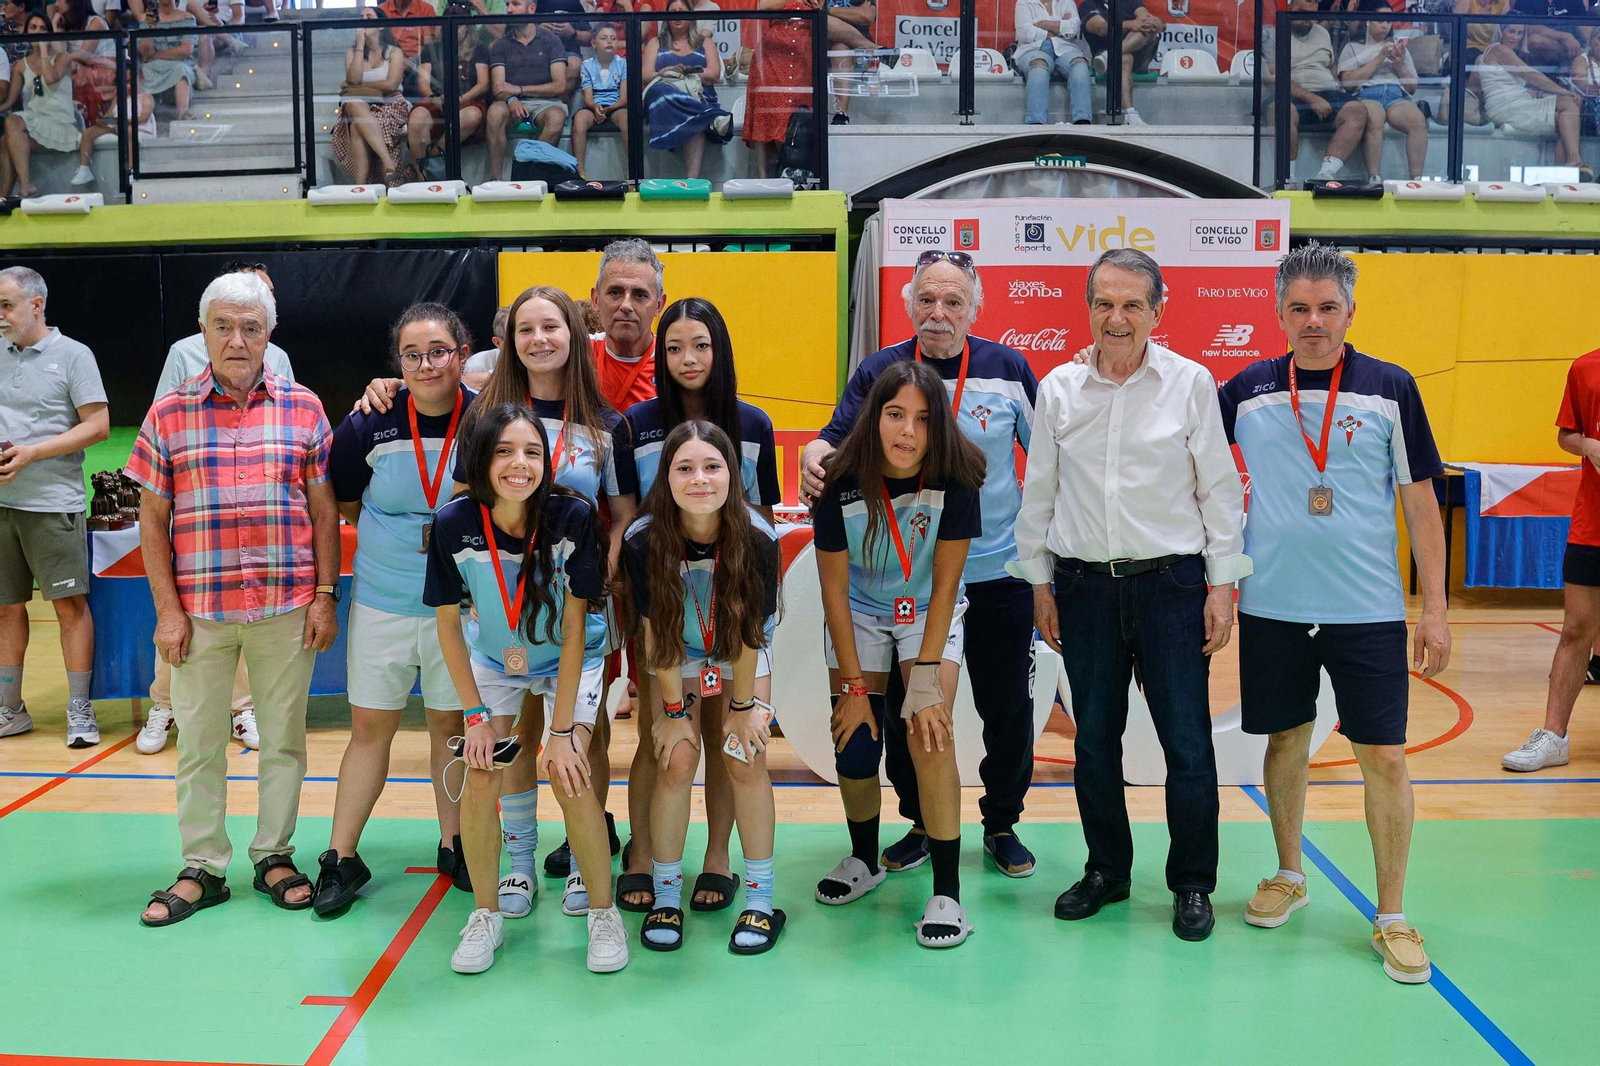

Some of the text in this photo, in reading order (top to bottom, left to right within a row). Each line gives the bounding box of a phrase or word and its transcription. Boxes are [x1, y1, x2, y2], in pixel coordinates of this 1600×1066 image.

[899, 19, 958, 37] Concel
[893, 226, 947, 235] CONCELLO
[1055, 215, 1156, 252] vide
[1195, 226, 1248, 235] CONCELLO
[900, 236, 941, 245] DE VIGO
[1201, 236, 1242, 245] DE VIGO
[1014, 244, 1052, 253] deporte
[1008, 279, 1046, 289] viaxes
[1197, 286, 1269, 298] FARO DE VIGO
[1201, 348, 1260, 358] new balance
[1252, 381, 1277, 394] ZICO
[373, 427, 399, 441] ZICO
[639, 429, 665, 441] ZICO
[498, 878, 529, 892] FILA
[567, 876, 585, 889] FI
[646, 912, 681, 926] FILA
[737, 914, 771, 931] FILA
